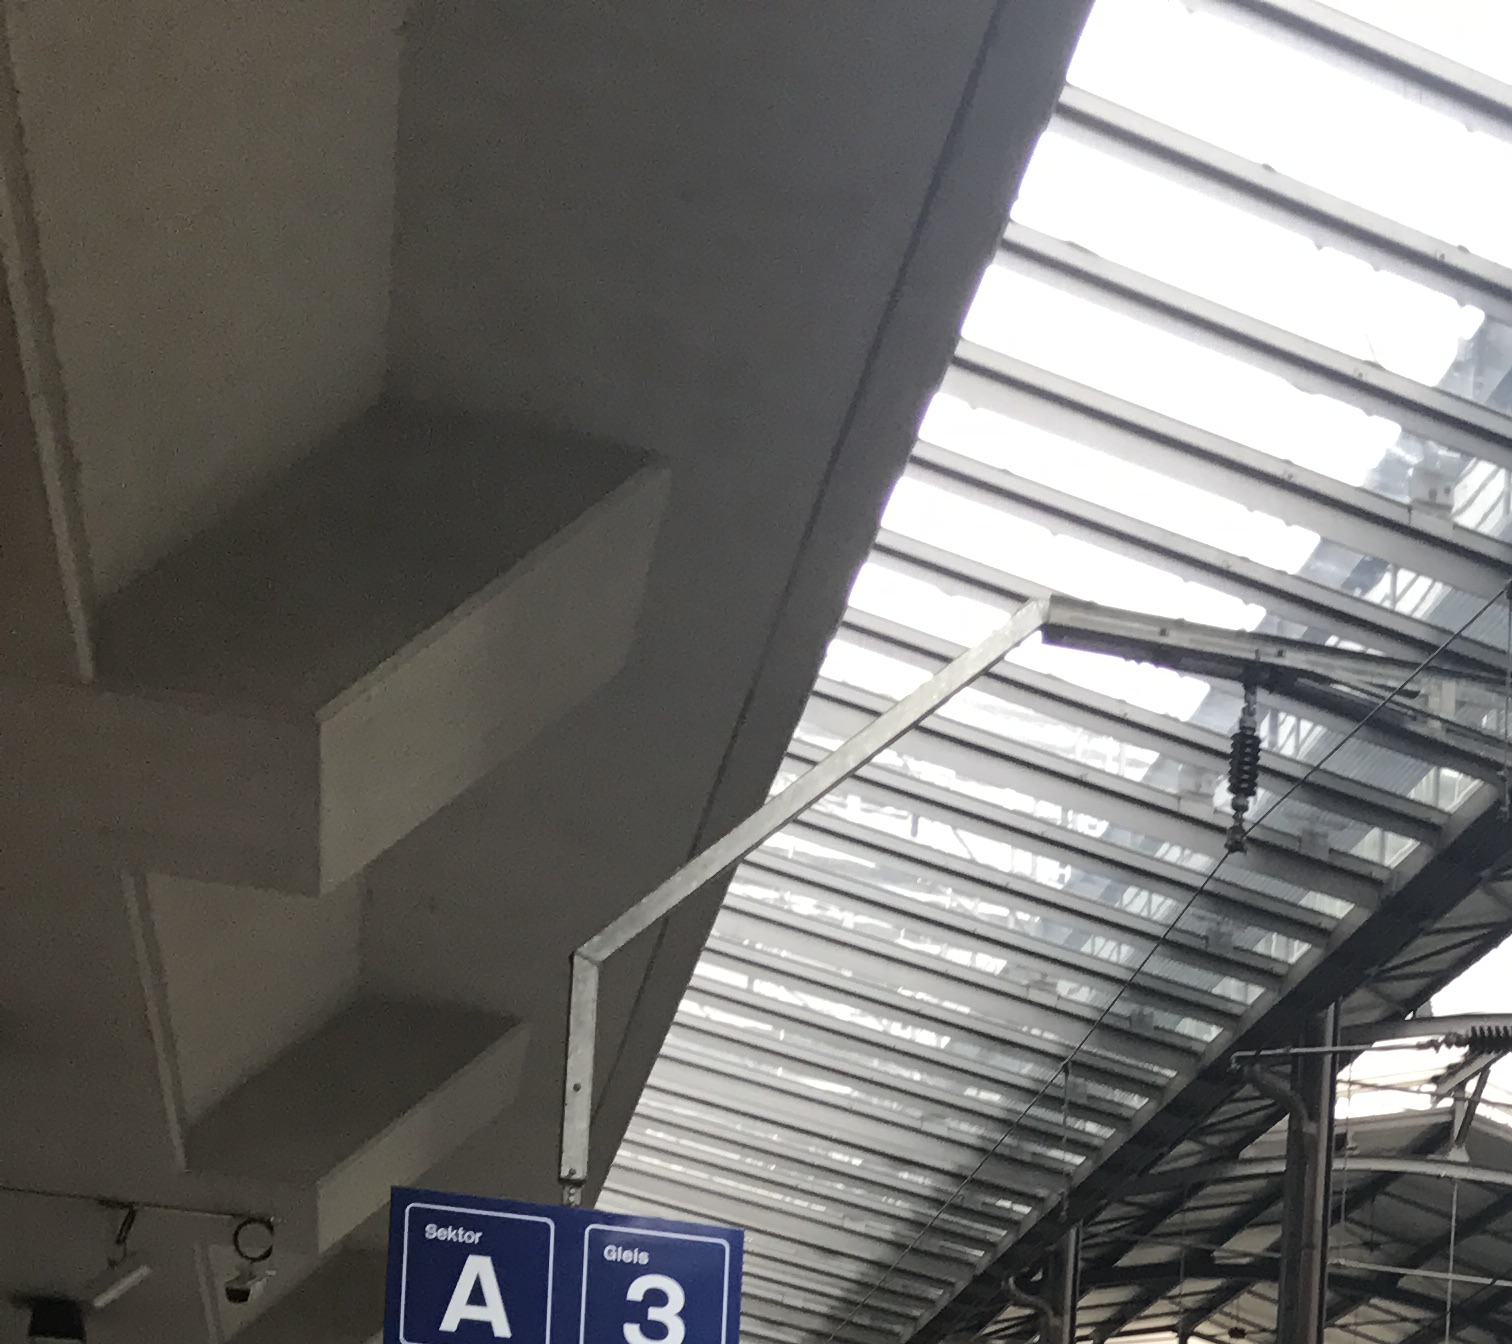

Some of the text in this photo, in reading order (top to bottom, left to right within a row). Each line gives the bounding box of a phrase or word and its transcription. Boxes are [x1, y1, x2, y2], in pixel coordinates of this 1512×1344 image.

[424, 1223, 484, 1245] Sektor
[603, 1244, 650, 1266] Gleis
[438, 1254, 513, 1340] A
